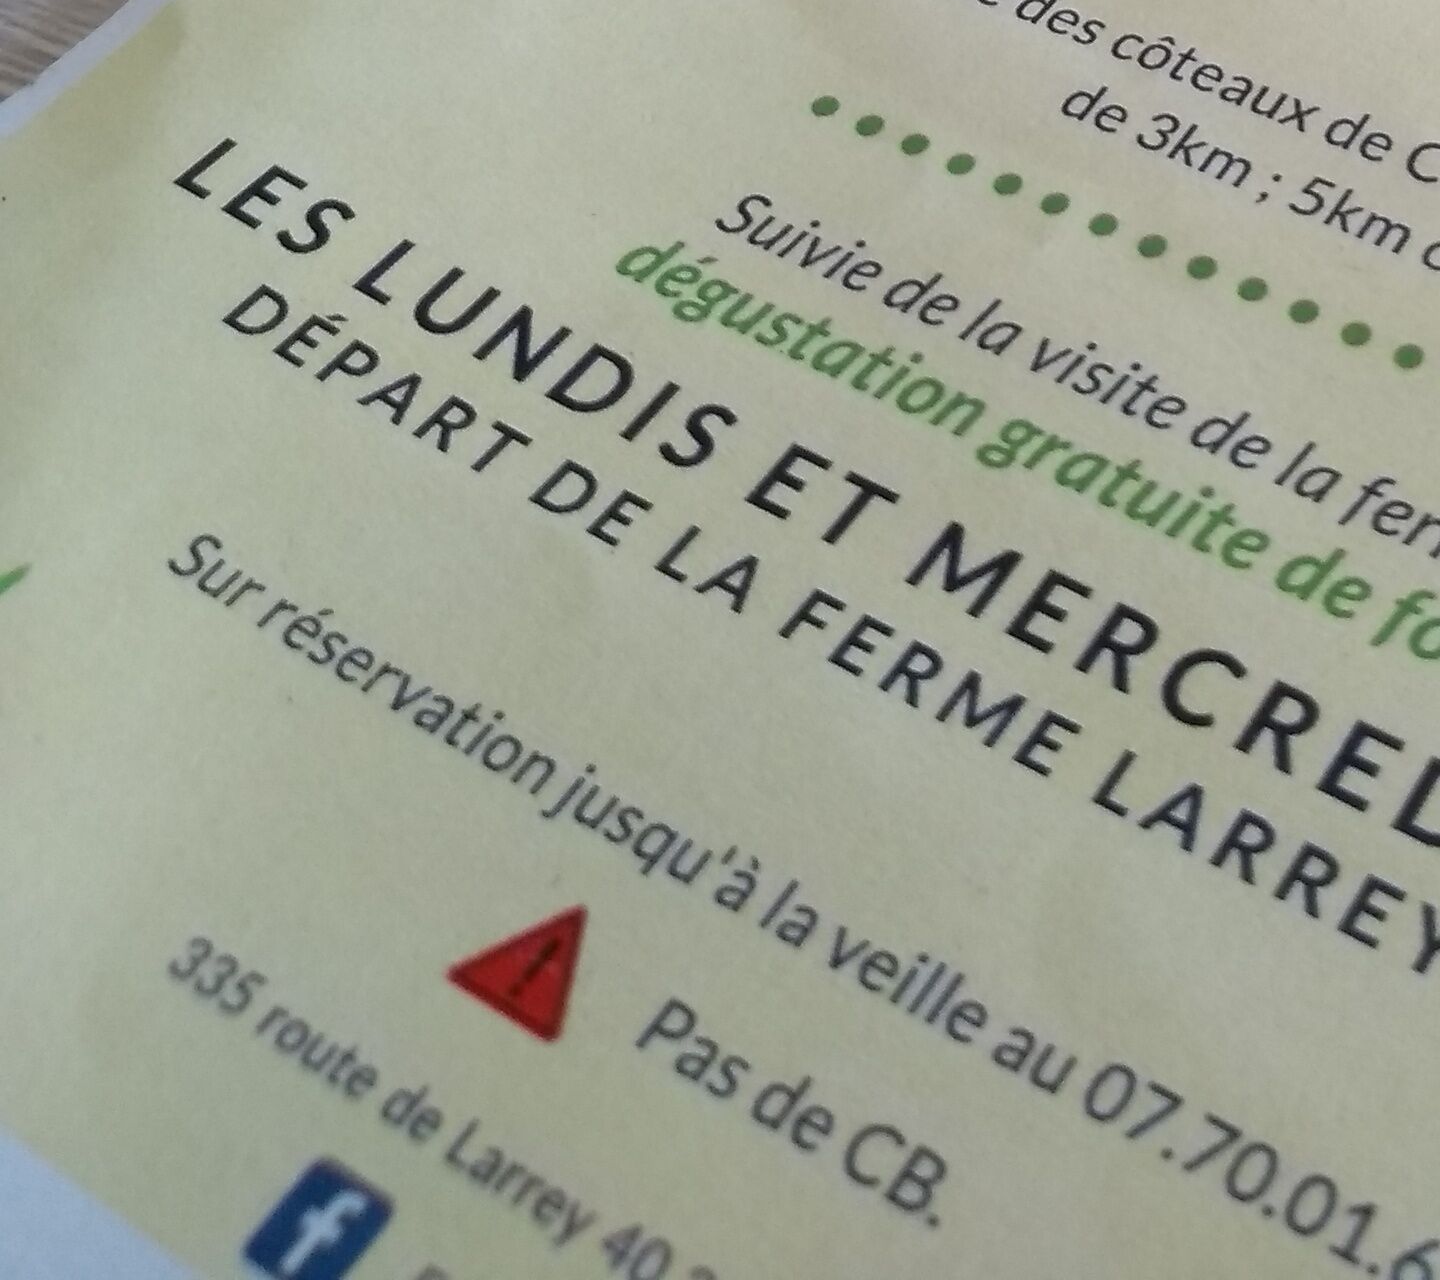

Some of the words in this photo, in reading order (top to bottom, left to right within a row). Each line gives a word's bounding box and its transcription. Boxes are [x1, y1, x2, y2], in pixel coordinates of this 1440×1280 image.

[1060, 85, 1129, 135] de
[1136, 111, 1254, 190] 3km
[1289, 176, 1413, 257] 5km
[1109, 35, 1320, 136] côteaux
[1324, 112, 1396, 164] de
[172, 137, 357, 255] LES
[351, 238, 739, 468] LUNDIS
[744, 442, 901, 546] ET
[615, 240, 987, 437] dégustation
[975, 416, 1271, 571] gratuite
[1275, 548, 1373, 621] de
[714, 192, 883, 294] Suivie
[883, 272, 962, 327] de
[959, 297, 1023, 357] la
[1030, 341, 1187, 431] visite
[1189, 410, 1273, 470] de
[1274, 440, 1342, 503] la
[222, 283, 534, 474] DÉPART
[528, 458, 655, 547] DE
[653, 524, 762, 615] LA
[777, 587, 1083, 778] FERME
[167, 532, 267, 609] Sur
[256, 607, 558, 796] réservation
[541, 763, 762, 913] jusqu'à
[758, 879, 821, 949] la
[829, 924, 991, 1046] veille
[991, 1024, 1078, 1094] au
[167, 936, 267, 1015] 335
[255, 1005, 379, 1100] route
[380, 1083, 444, 1142] de
[443, 1117, 598, 1247] Larrey
[634, 996, 751, 1100] Pas
[751, 1073, 837, 1153] de
[843, 1122, 949, 1230] CB.
